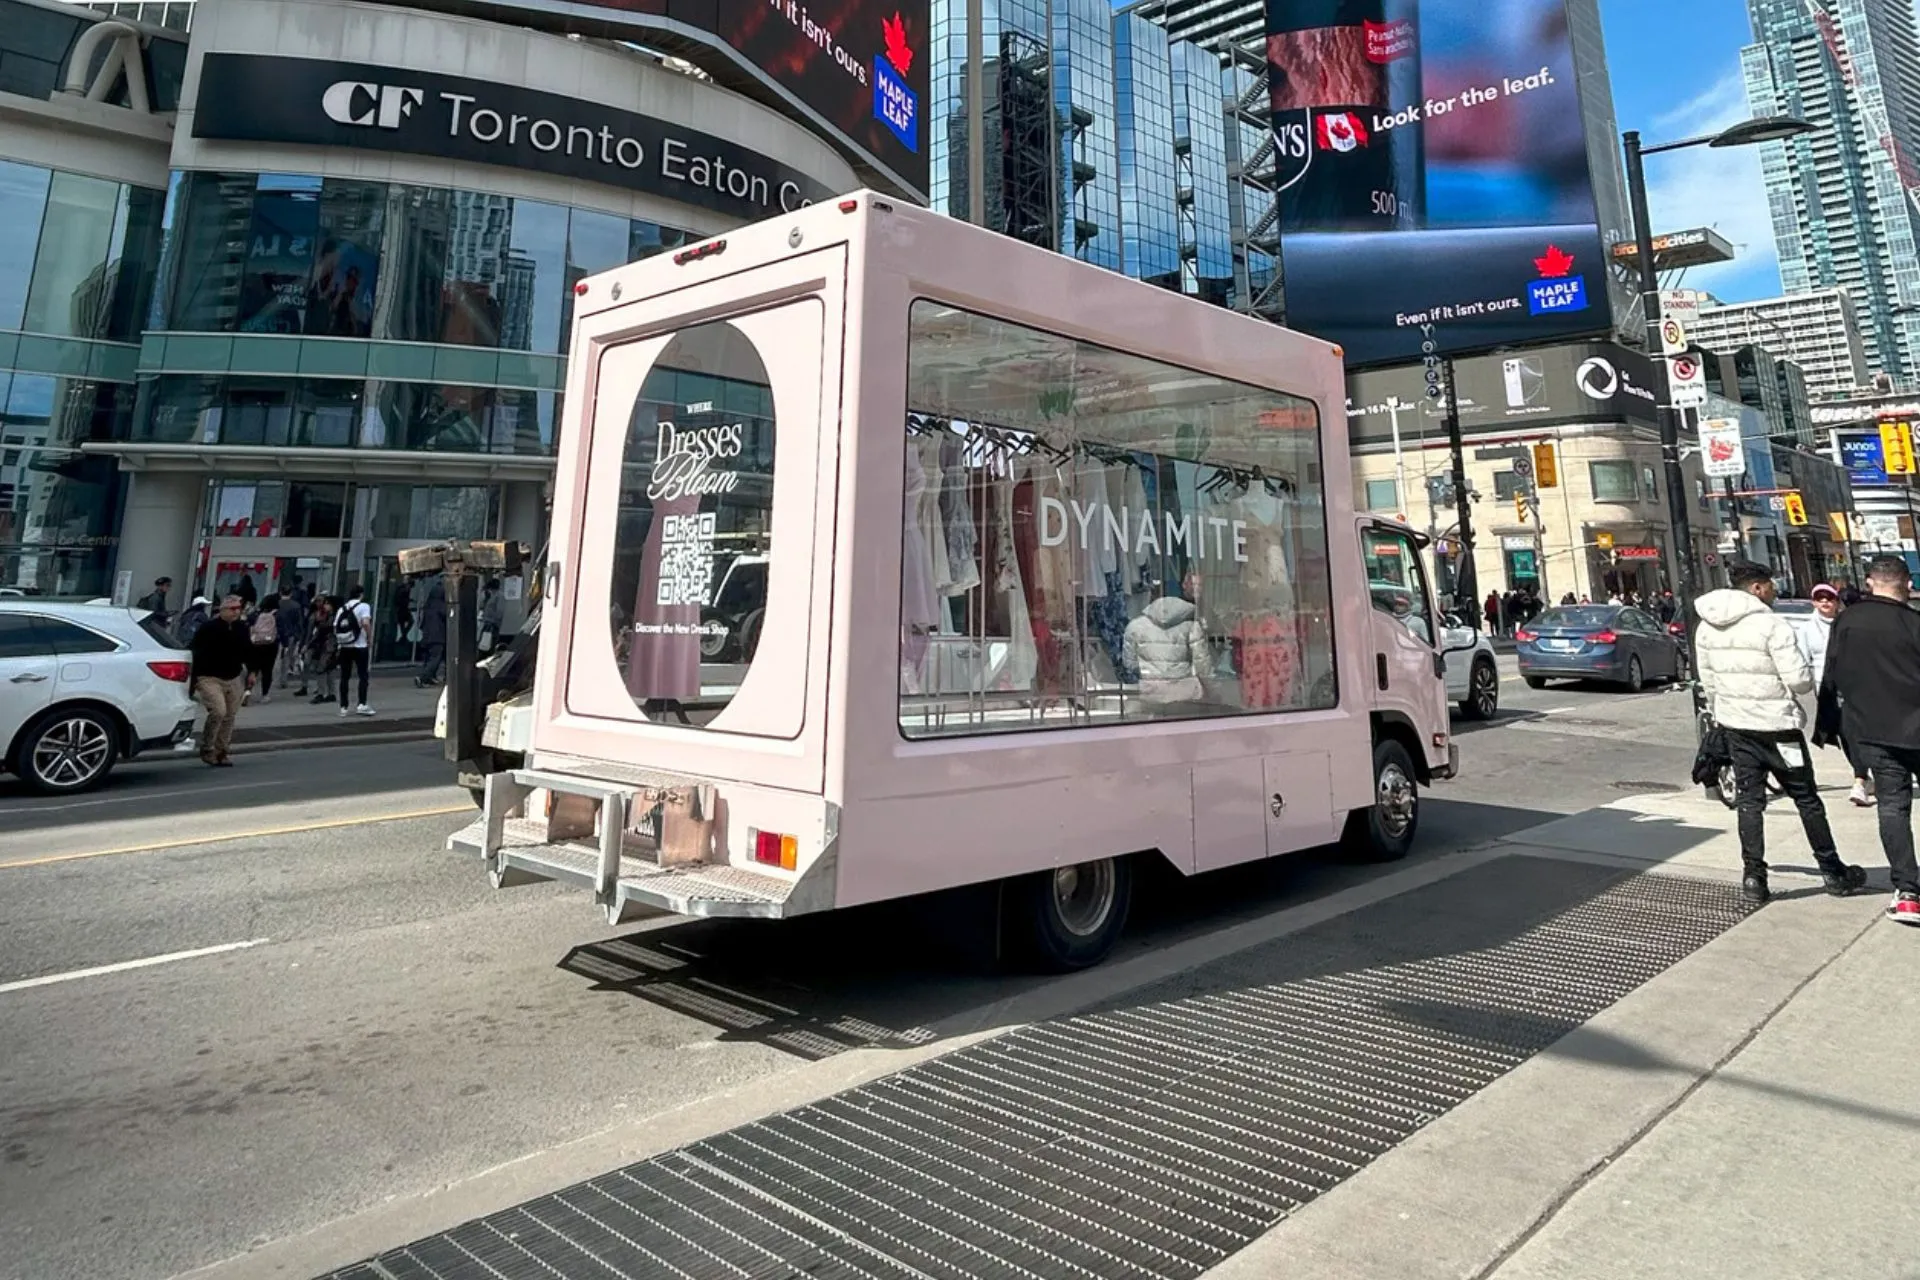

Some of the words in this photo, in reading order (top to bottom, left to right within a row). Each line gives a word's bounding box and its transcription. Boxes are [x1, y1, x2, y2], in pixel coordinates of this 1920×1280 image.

[802, 8, 832, 55] isn't
[835, 46, 868, 86] ours.
[878, 70, 914, 118] MAPLE
[883, 96, 908, 131] LEAF
[1373, 105, 1421, 132] Look
[1424, 98, 1456, 117] for
[1460, 87, 1498, 107] the
[1503, 66, 1555, 96] leaf.
[322, 80, 424, 128] CF
[440, 92, 644, 168] Toronto
[661, 137, 768, 207] Eaton
[1371, 190, 1396, 215] 500
[1533, 281, 1578, 299] MAPLE
[1540, 294, 1574, 309] LEAF
[1663, 301, 1696, 310] STANDING
[1396, 313, 1427, 326] Even
[1430, 308, 1440, 321] if
[1443, 306, 1453, 318] it
[1456, 301, 1484, 316] isn't
[1487, 297, 1522, 312] ours.
[655, 421, 742, 465] Dresses
[647, 450, 739, 501] Bloom
[1040, 497, 1249, 563] DYNAMITE
[635, 622, 661, 633] Discover
[663, 622, 673, 634] the
[674, 623, 690, 634] New
[690, 623, 710, 635] Dress
[710, 623, 729, 638] Shop
